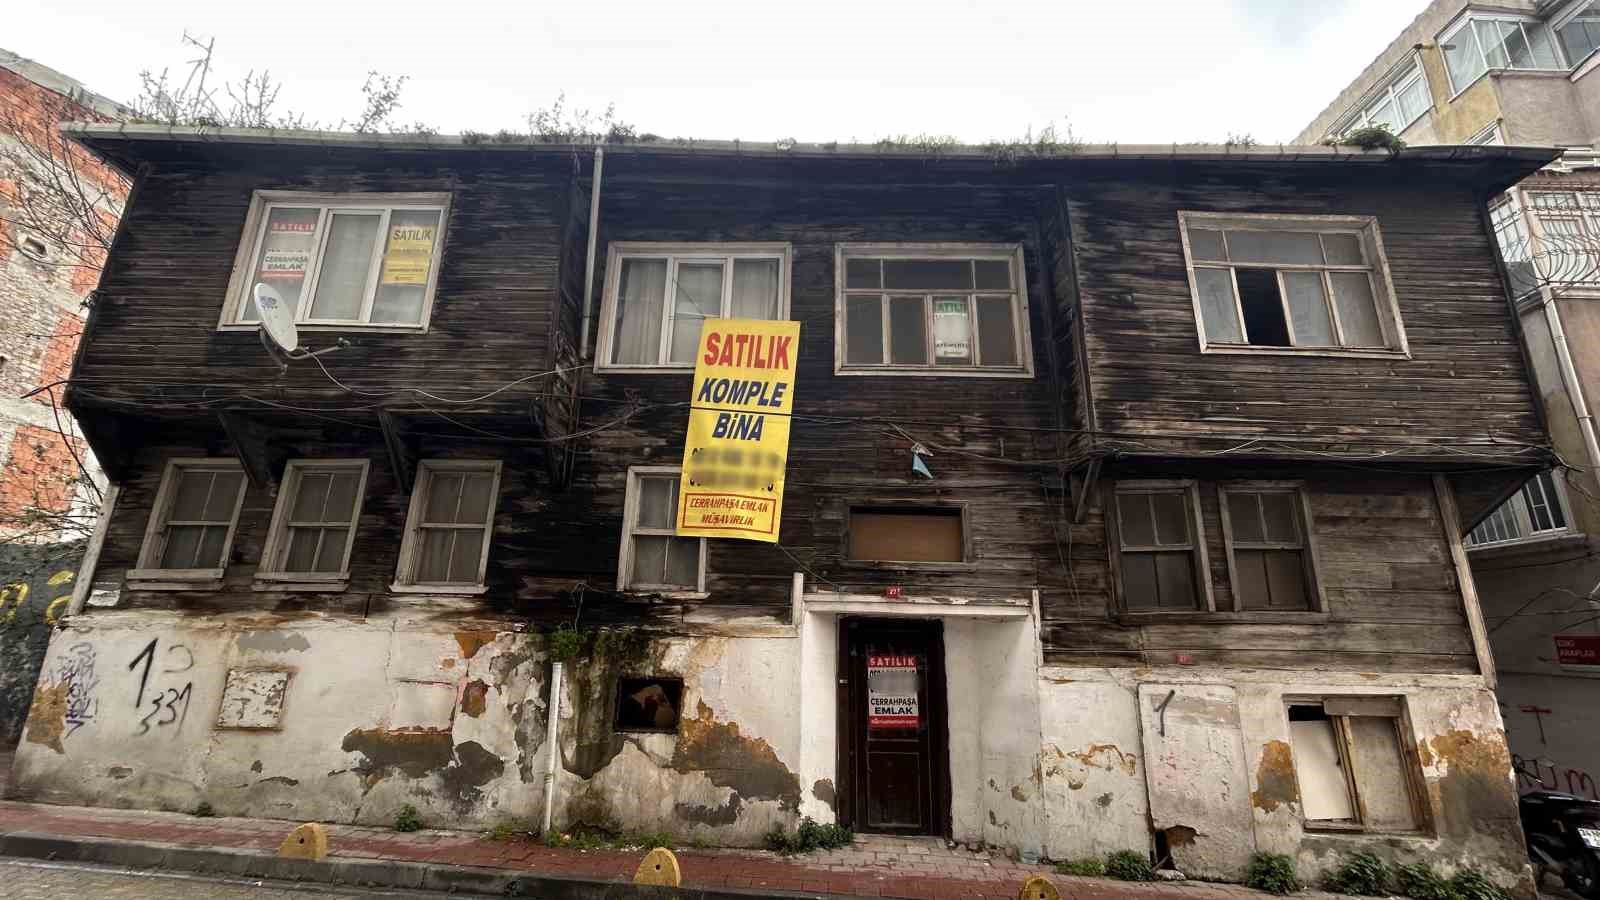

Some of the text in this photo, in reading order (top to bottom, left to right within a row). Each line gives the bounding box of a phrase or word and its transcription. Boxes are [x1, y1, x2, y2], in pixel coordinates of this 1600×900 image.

[392, 230, 432, 240] SATILIK
[703, 332, 791, 369] SATILIK
[698, 378, 787, 408] KOMPLE
[740, 500, 769, 513] EMLAK
[869, 657, 916, 667] SATILIK
[875, 707, 912, 715] EMLAK
